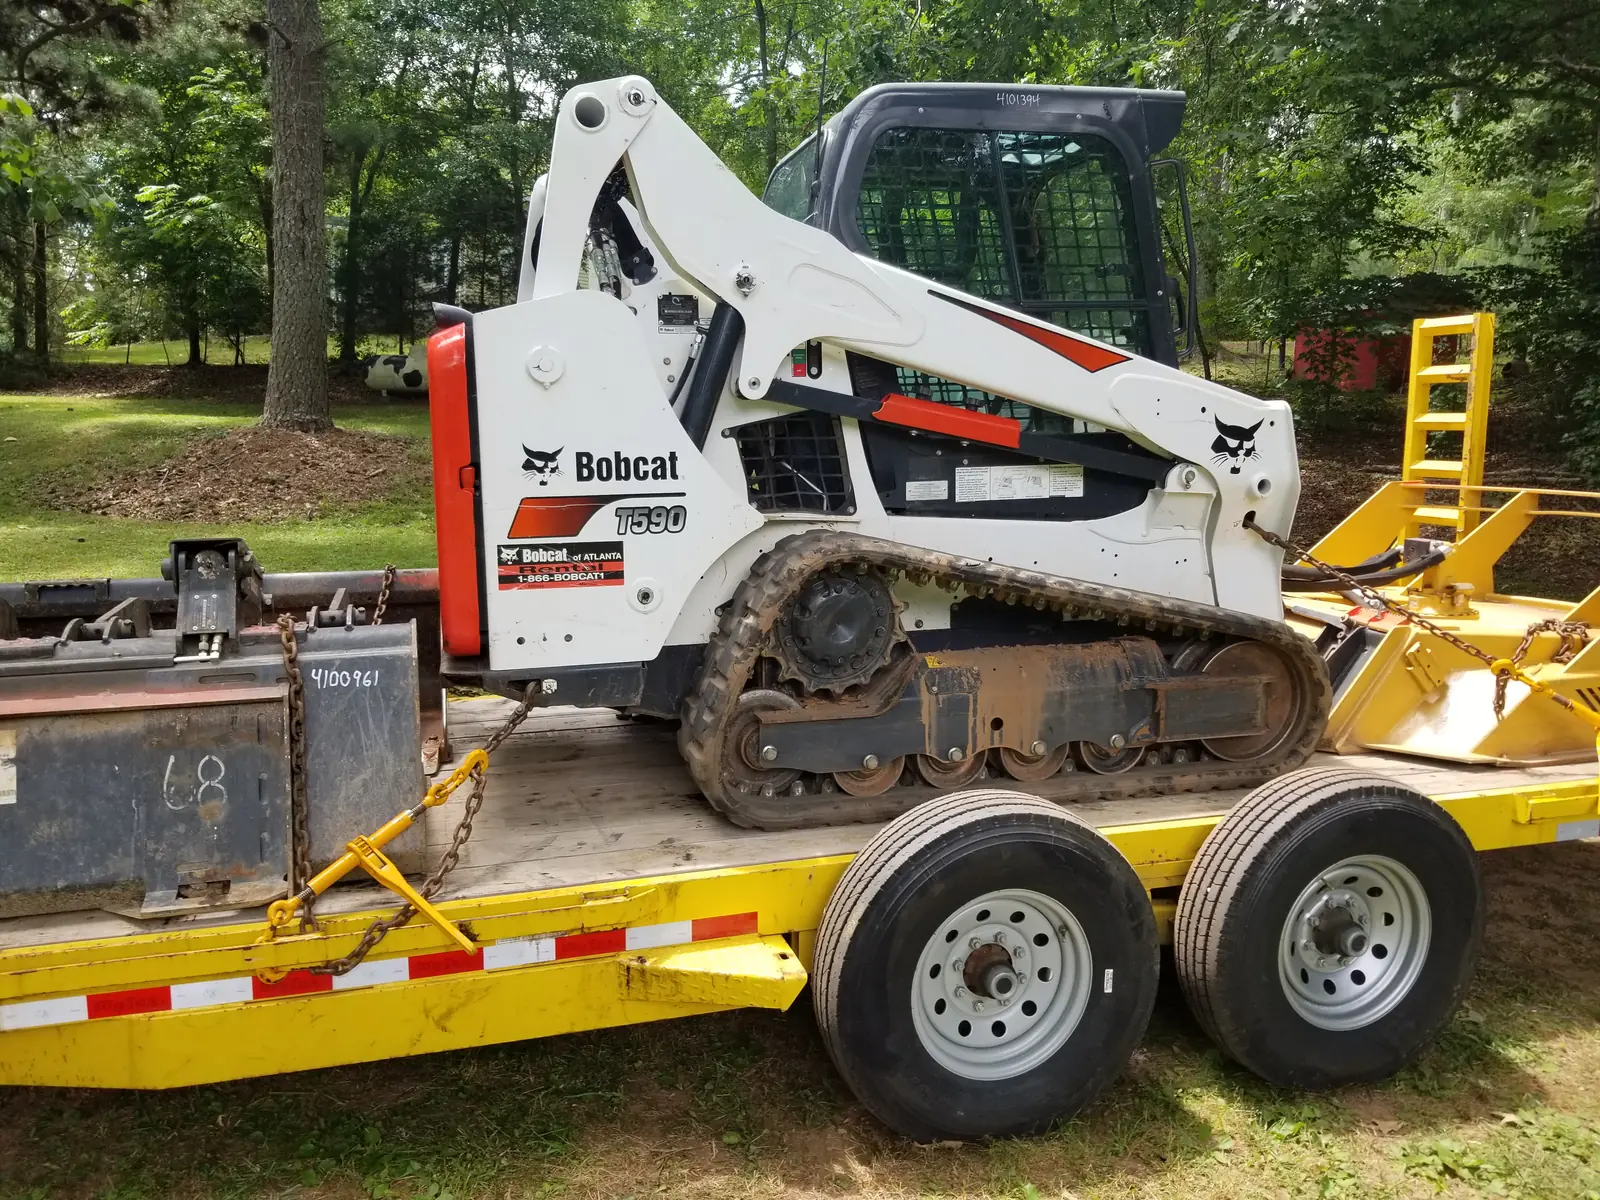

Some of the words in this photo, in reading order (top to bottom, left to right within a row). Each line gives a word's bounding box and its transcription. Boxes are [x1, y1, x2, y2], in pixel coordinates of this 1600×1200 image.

[997, 92, 1040, 107] 4101394
[575, 451, 679, 481] Bobcat
[615, 505, 687, 535] T590
[522, 548, 568, 563] Bobcat
[572, 553, 582, 561] of
[583, 552, 622, 561] ATLANTA
[519, 563, 604, 574] Rental
[517, 573, 605, 583] 1-866-BOBCAT1
[311, 668, 379, 689] 4100961
